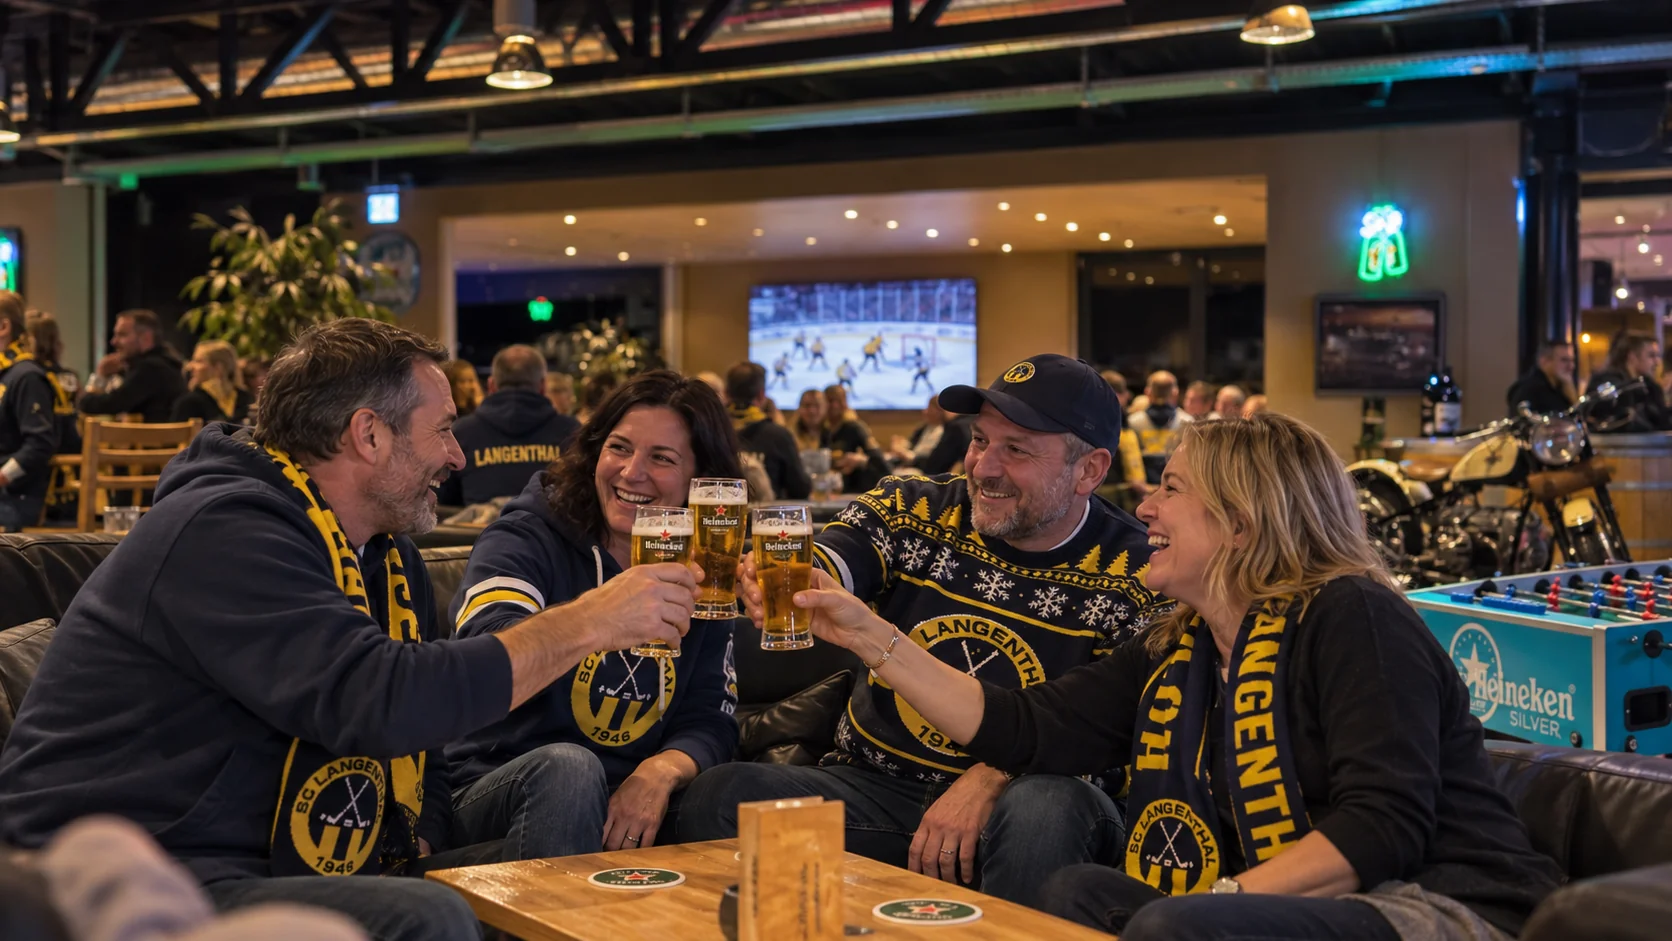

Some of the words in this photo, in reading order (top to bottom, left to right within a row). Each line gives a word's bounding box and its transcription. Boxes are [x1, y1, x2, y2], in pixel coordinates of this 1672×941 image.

[919, 618, 1041, 686] LANGENTH
[578, 659, 595, 684] SC
[1474, 668, 1575, 721] Heineken
[591, 726, 631, 744] 1946
[1234, 600, 1302, 862] ANGENTH
[1509, 710, 1562, 739] SILVER
[918, 725, 964, 754] 194
[296, 788, 316, 814] SC
[1129, 832, 1143, 854] SC
[1140, 803, 1217, 869] LANGENTHAL
[316, 856, 354, 875] 1946
